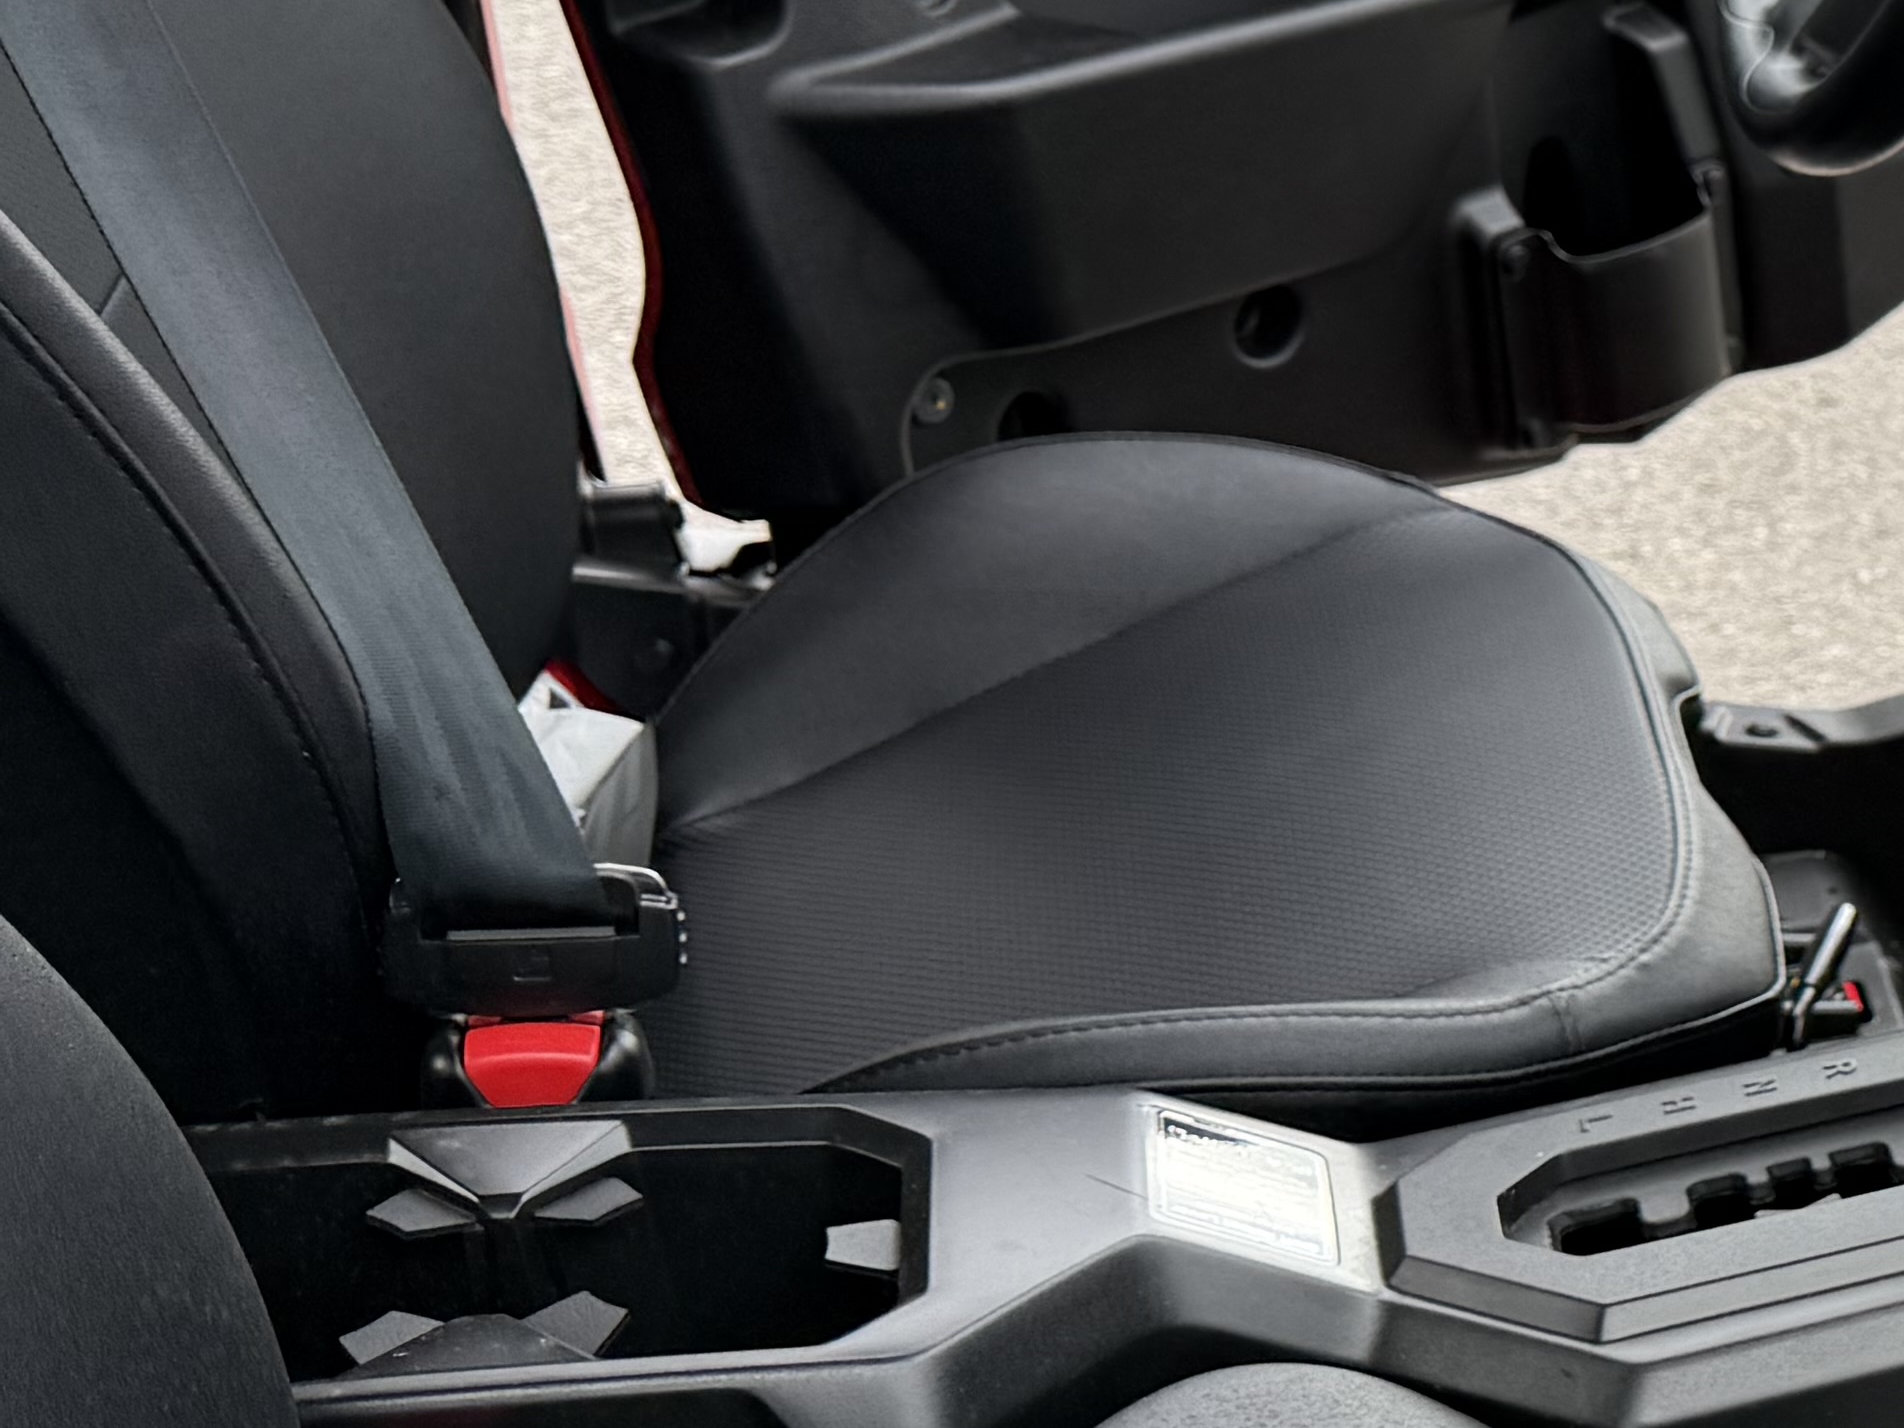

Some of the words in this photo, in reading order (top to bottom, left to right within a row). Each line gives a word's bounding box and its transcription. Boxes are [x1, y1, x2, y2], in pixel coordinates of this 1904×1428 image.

[1822, 1057, 1857, 1079] R
[1741, 1077, 1778, 1097] N
[1661, 1096, 1697, 1116] H
[1579, 1114, 1613, 1134] L
